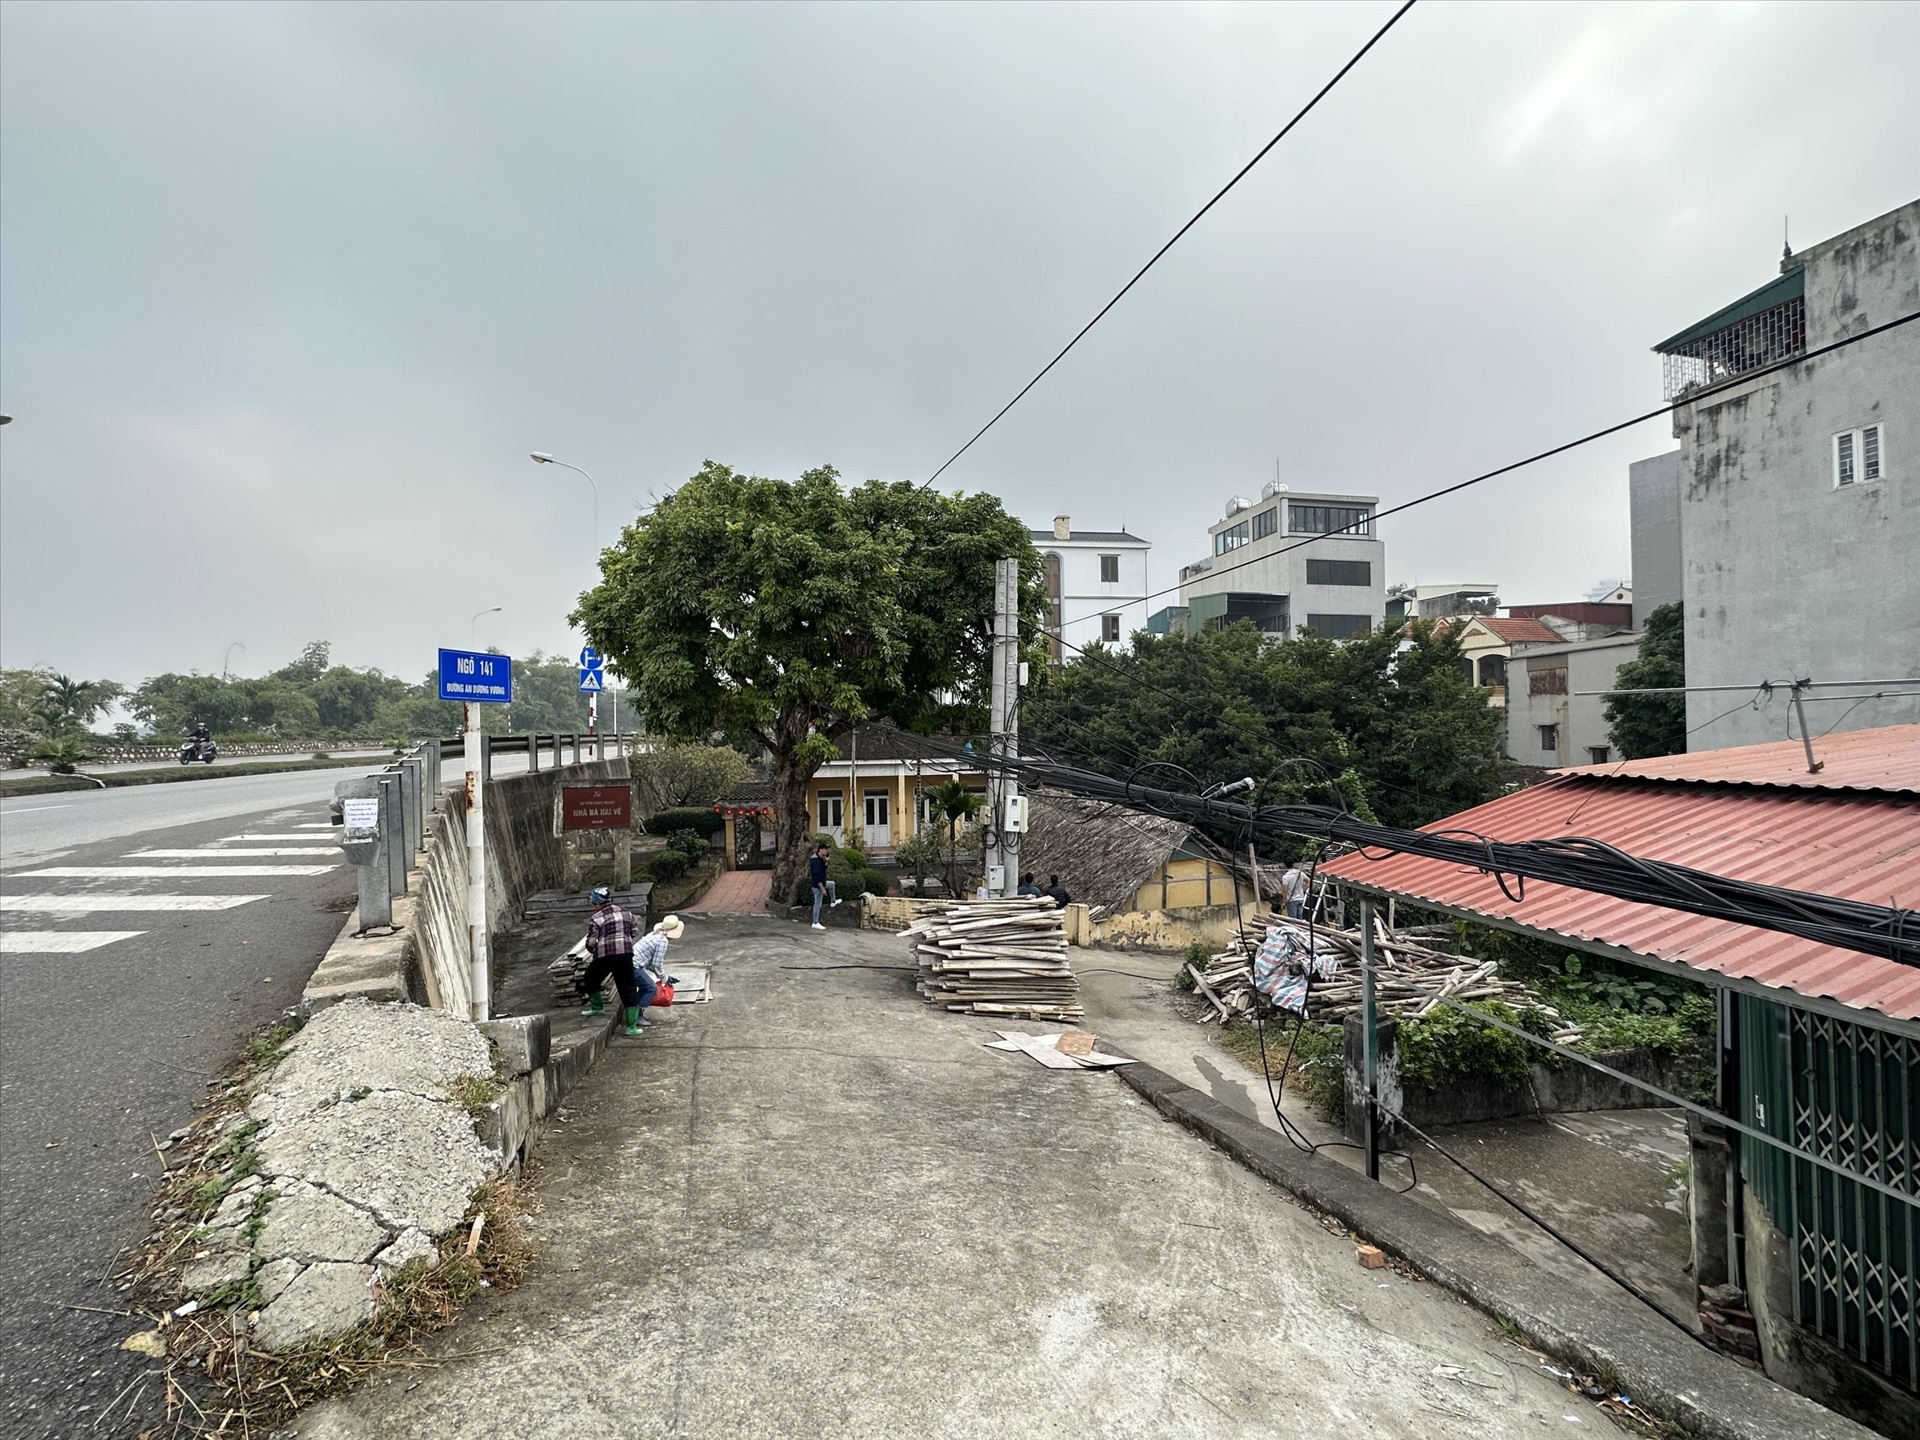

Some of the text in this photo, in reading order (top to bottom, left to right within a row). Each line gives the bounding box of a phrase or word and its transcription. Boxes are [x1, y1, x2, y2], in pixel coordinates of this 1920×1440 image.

[457, 656, 493, 676] NGÕ 141
[465, 684, 472, 694] AN
[573, 808, 588, 817] NHÀ
[589, 807, 599, 816] BÀ
[600, 808, 612, 816] HAI
